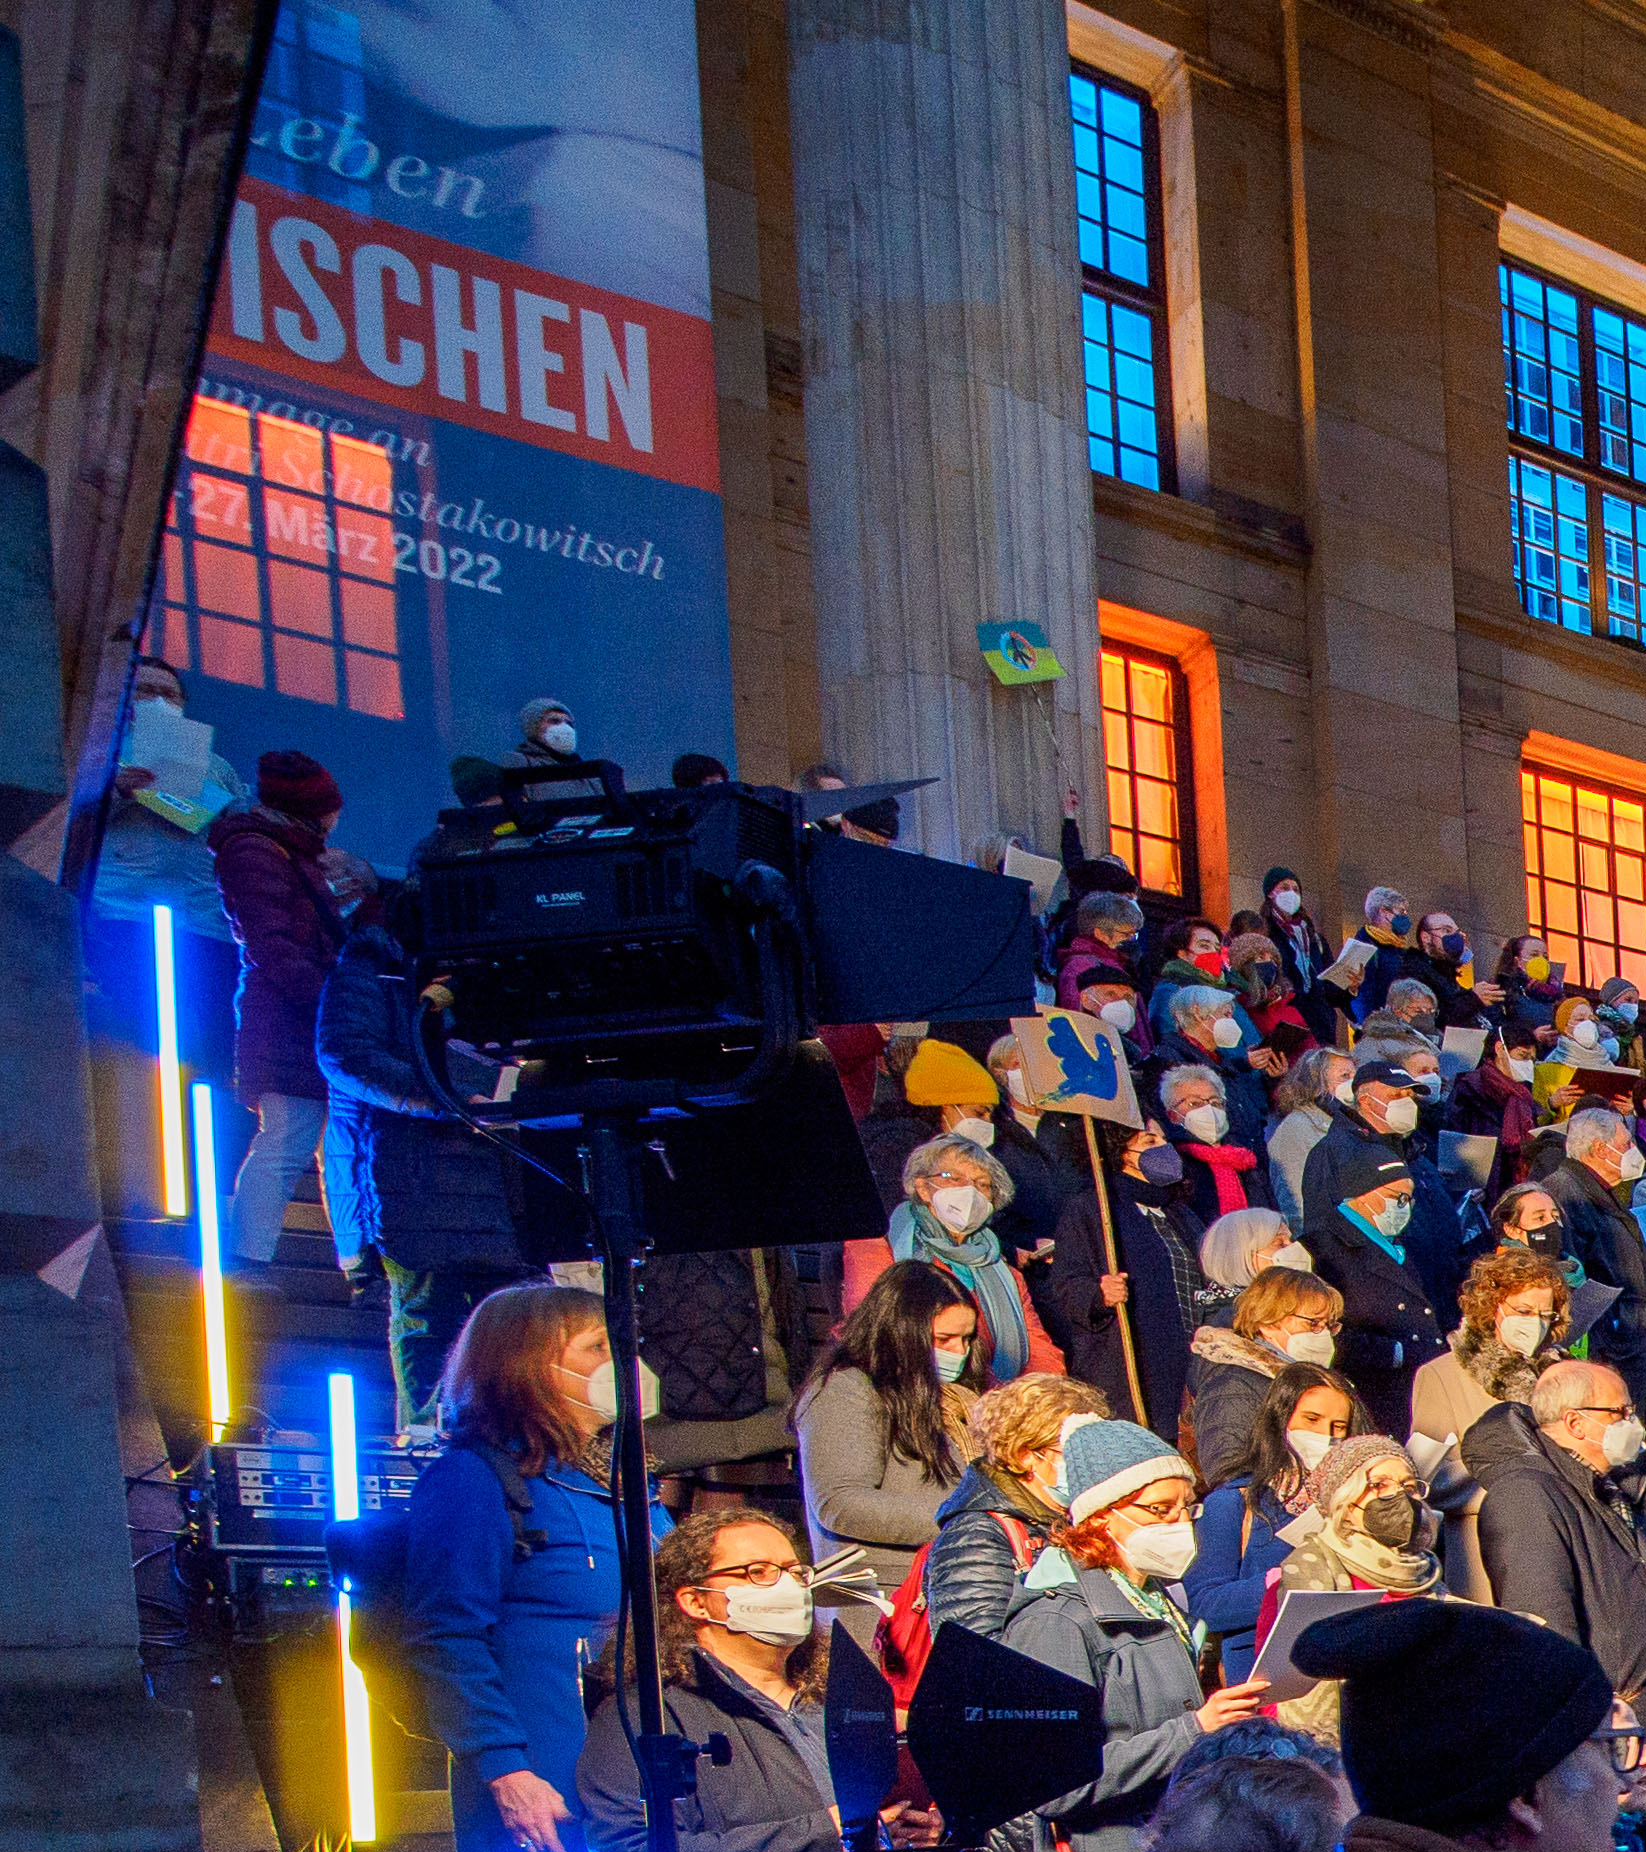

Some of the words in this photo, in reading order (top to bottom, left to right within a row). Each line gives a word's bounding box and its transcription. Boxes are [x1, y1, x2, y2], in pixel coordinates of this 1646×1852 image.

[250, 110, 487, 219] eben
[229, 199, 653, 453] ISCHEN
[266, 497, 380, 564] März
[393, 531, 502, 595] 2022
[277, 449, 666, 581] Schostakowitsch
[988, 1709, 1079, 1720] SENNHEISER
